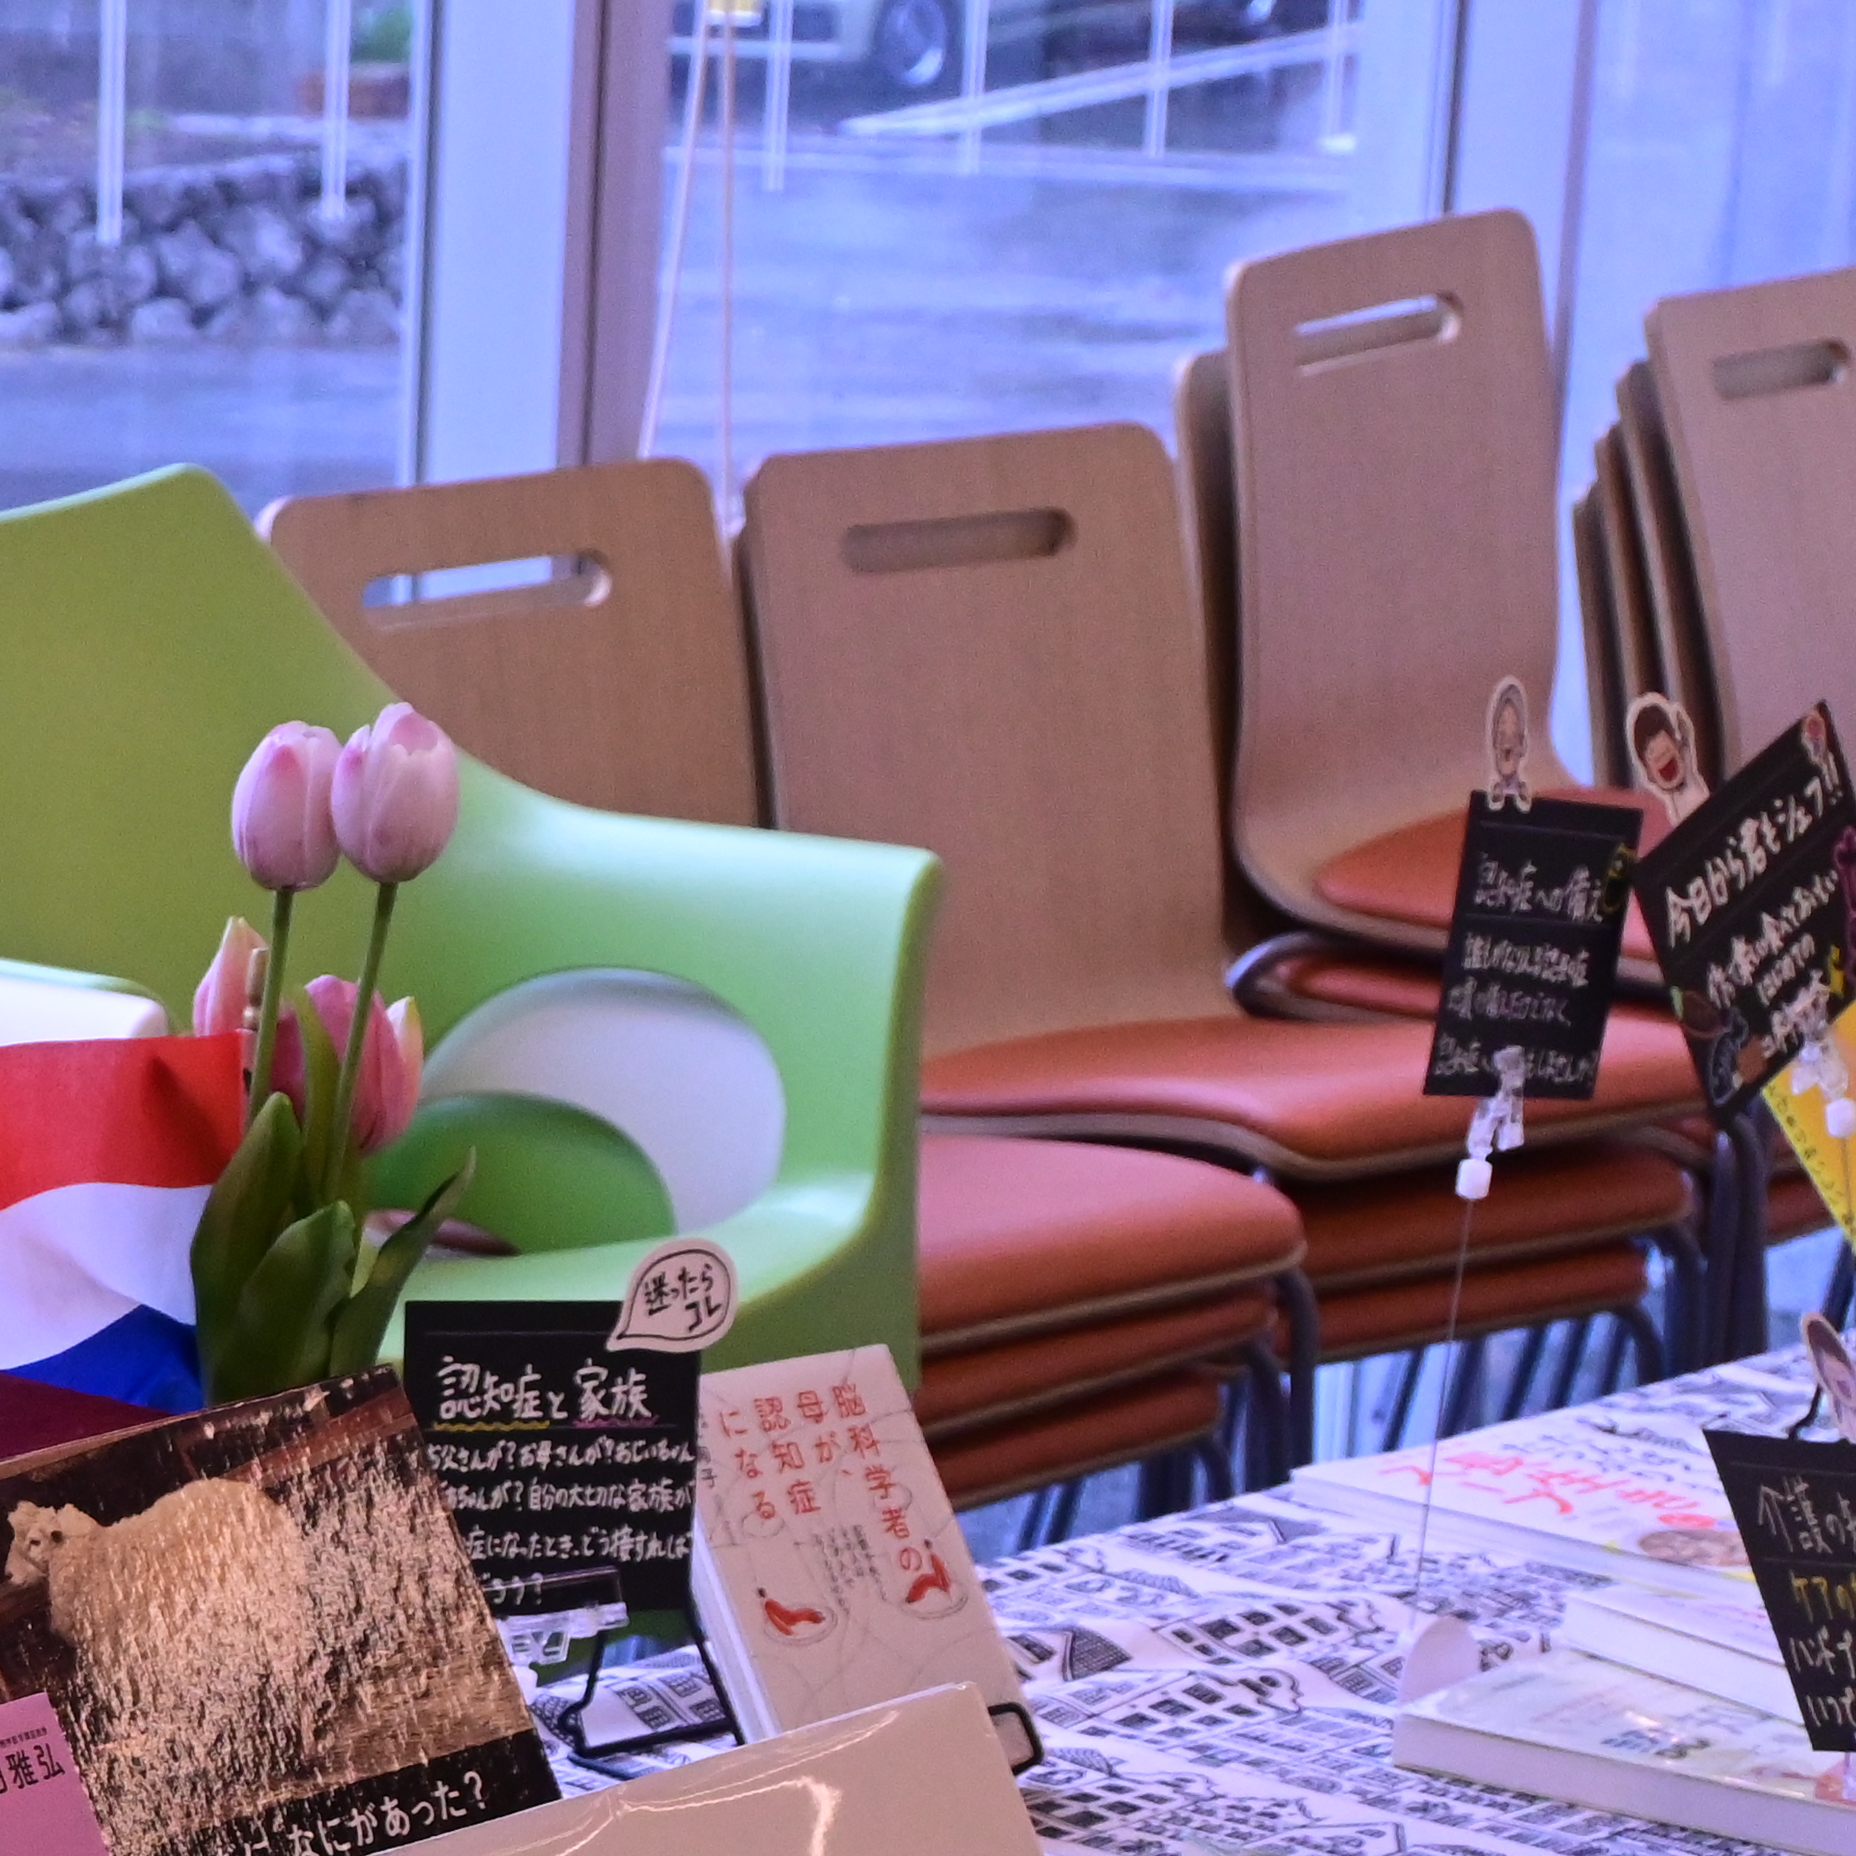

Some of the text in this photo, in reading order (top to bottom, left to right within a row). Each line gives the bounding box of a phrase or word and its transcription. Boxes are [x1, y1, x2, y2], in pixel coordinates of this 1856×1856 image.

[644, 1262, 716, 1316] 迷ったら
[688, 1297, 721, 1332] コレ
[438, 1356, 652, 1420] 認知症と家族
[720, 1411, 776, 1519] になる
[754, 1396, 821, 1515] 認知症
[832, 1383, 923, 1571] 脳科学者の
